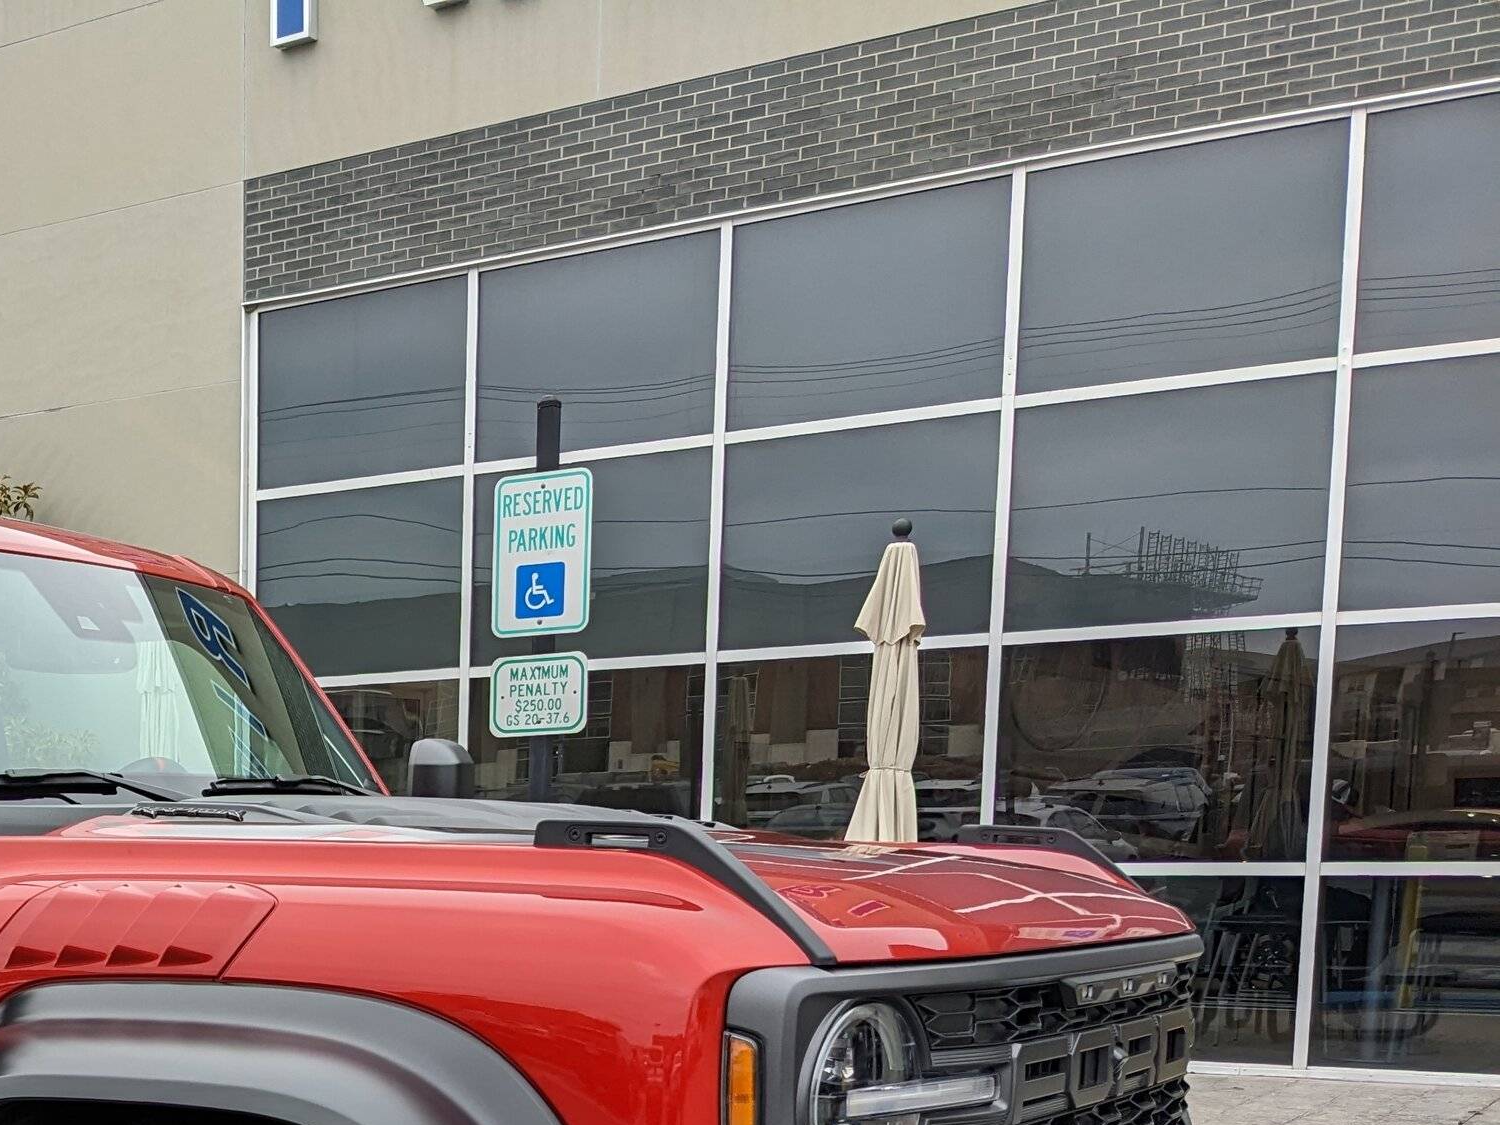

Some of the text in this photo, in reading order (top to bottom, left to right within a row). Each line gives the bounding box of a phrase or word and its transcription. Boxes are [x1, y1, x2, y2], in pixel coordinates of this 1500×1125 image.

[502, 486, 583, 518] RESERVED
[508, 523, 576, 553] PARKING
[510, 664, 569, 682] MAXIMUM
[509, 681, 568, 698] PENALTY
[515, 697, 562, 714] $250.00
[506, 711, 570, 726] GS 20-37.6
